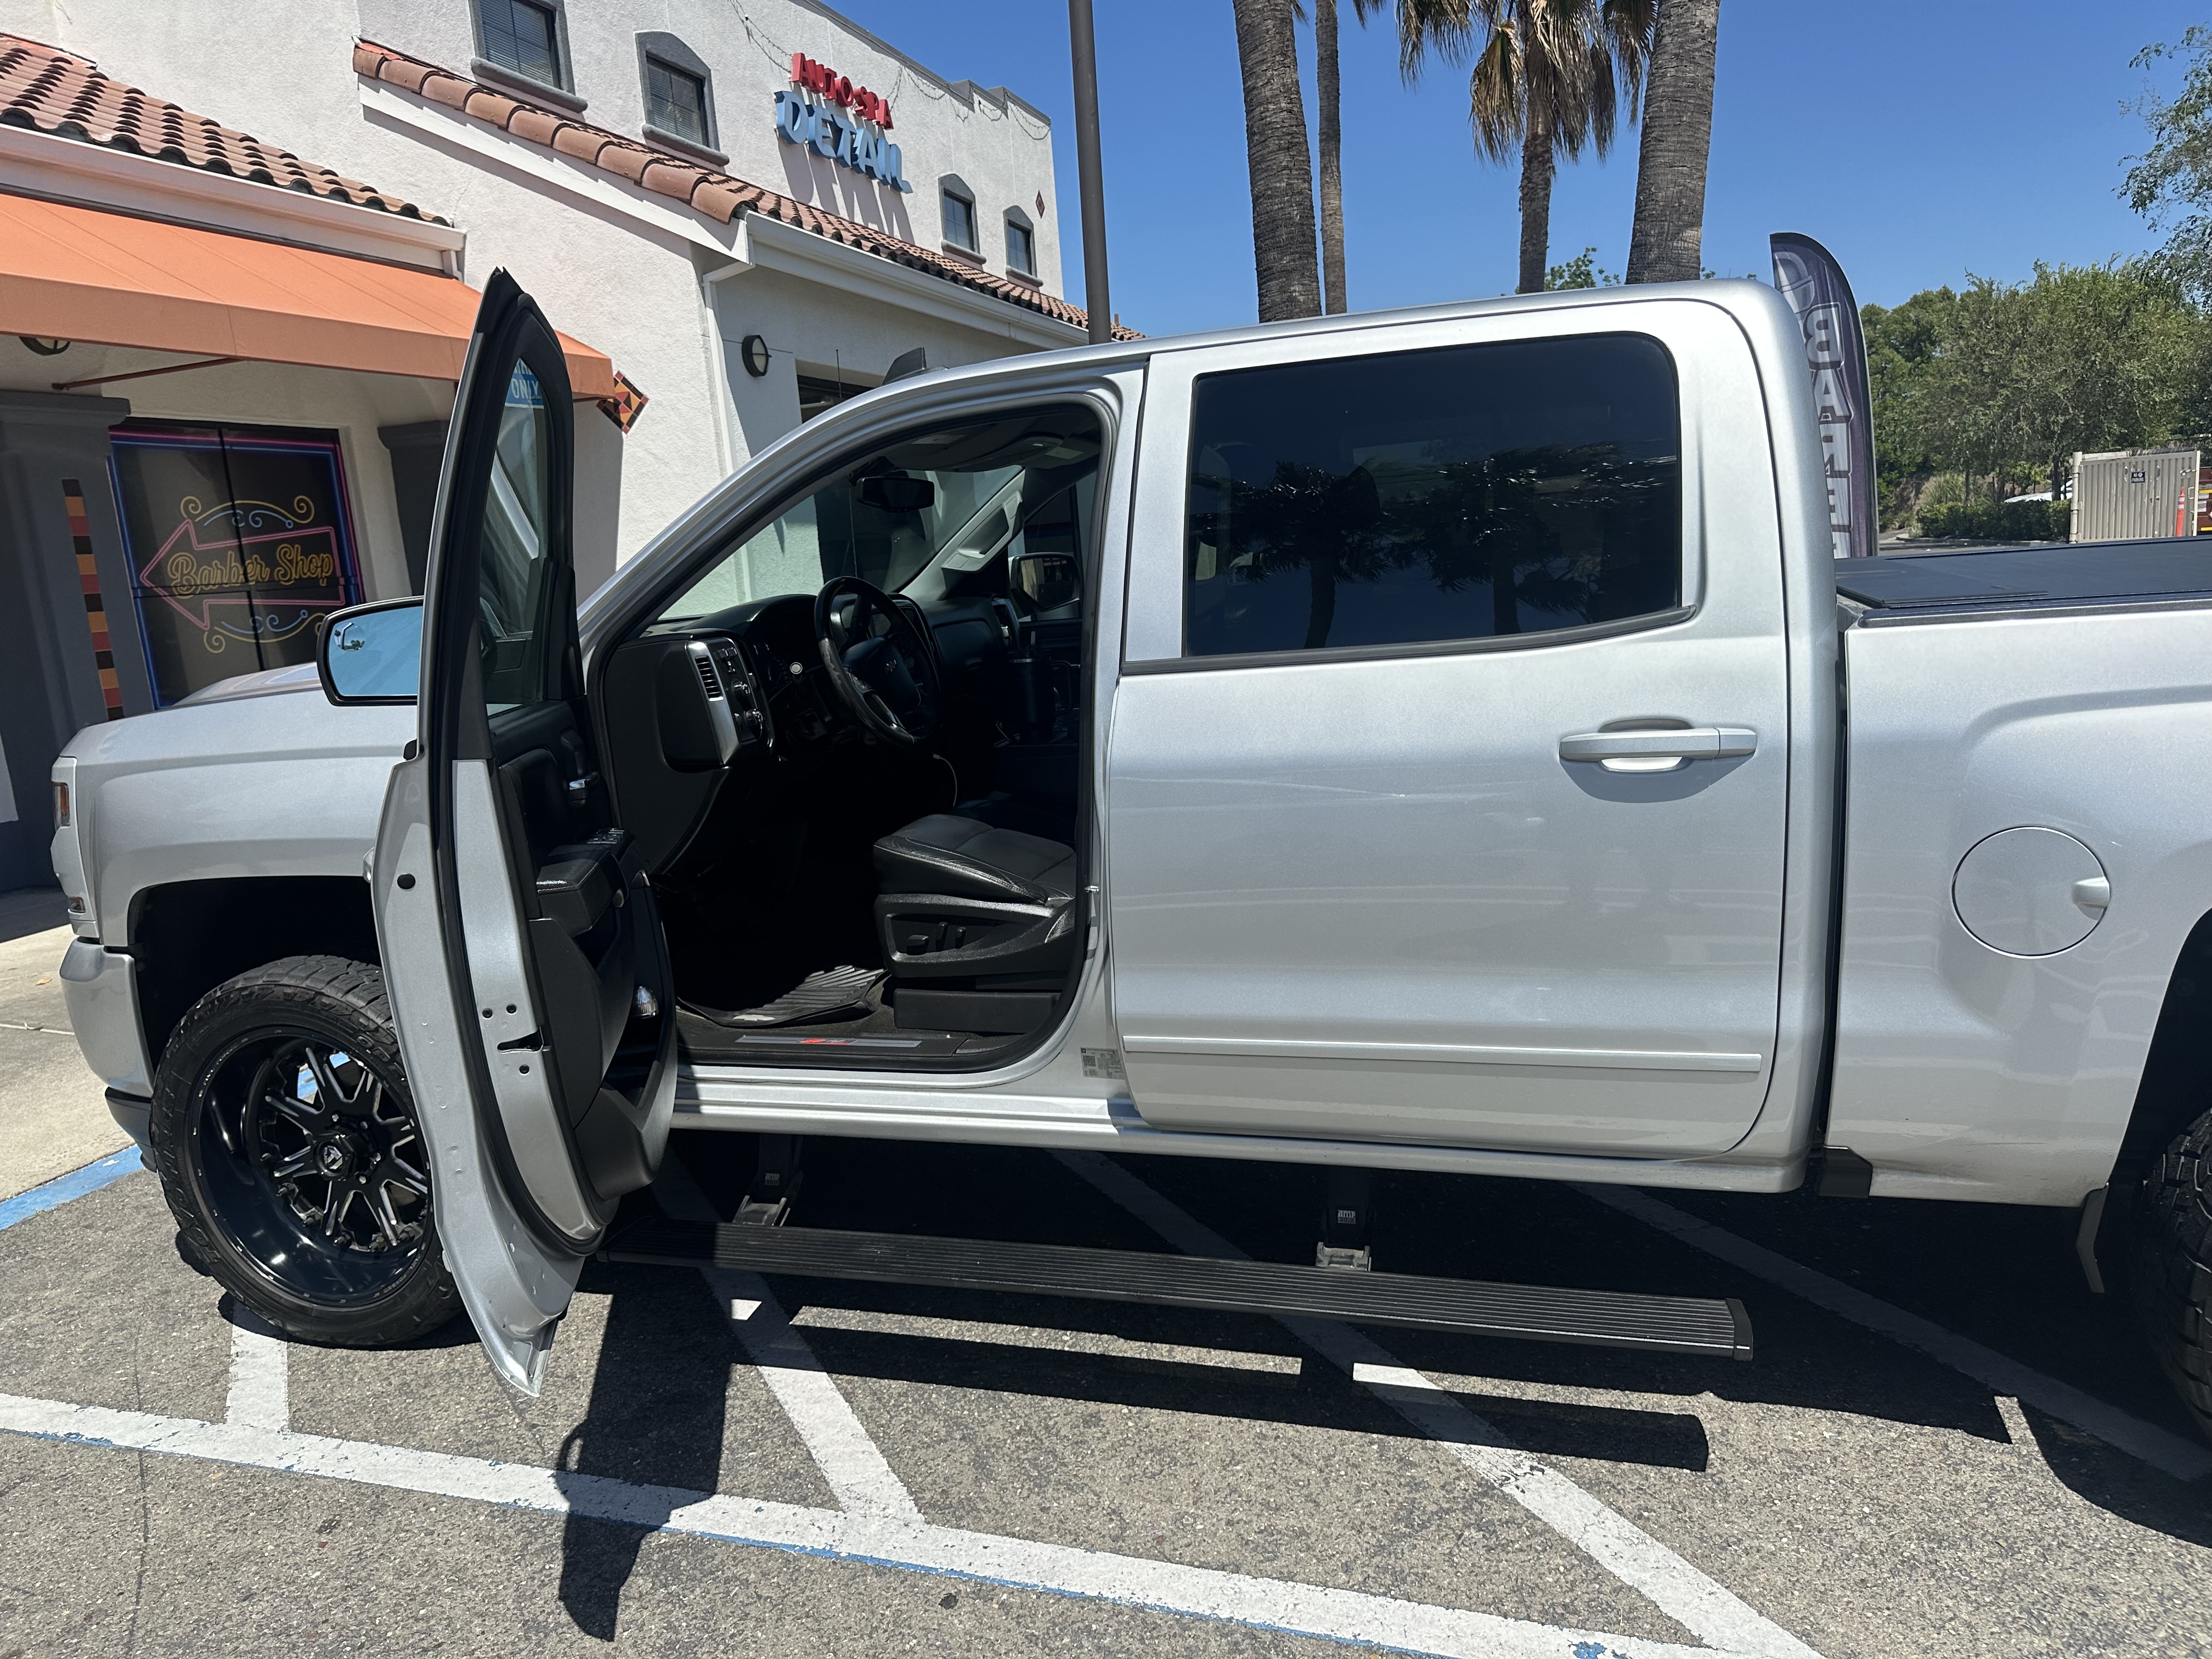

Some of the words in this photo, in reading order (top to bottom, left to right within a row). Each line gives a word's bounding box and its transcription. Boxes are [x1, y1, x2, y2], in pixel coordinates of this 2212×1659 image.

[791, 53, 854, 107] AUTO
[853, 86, 894, 130] SPA
[774, 90, 913, 194] DETAIL
[167, 551, 270, 599] Barber
[275, 543, 334, 586] Shop
